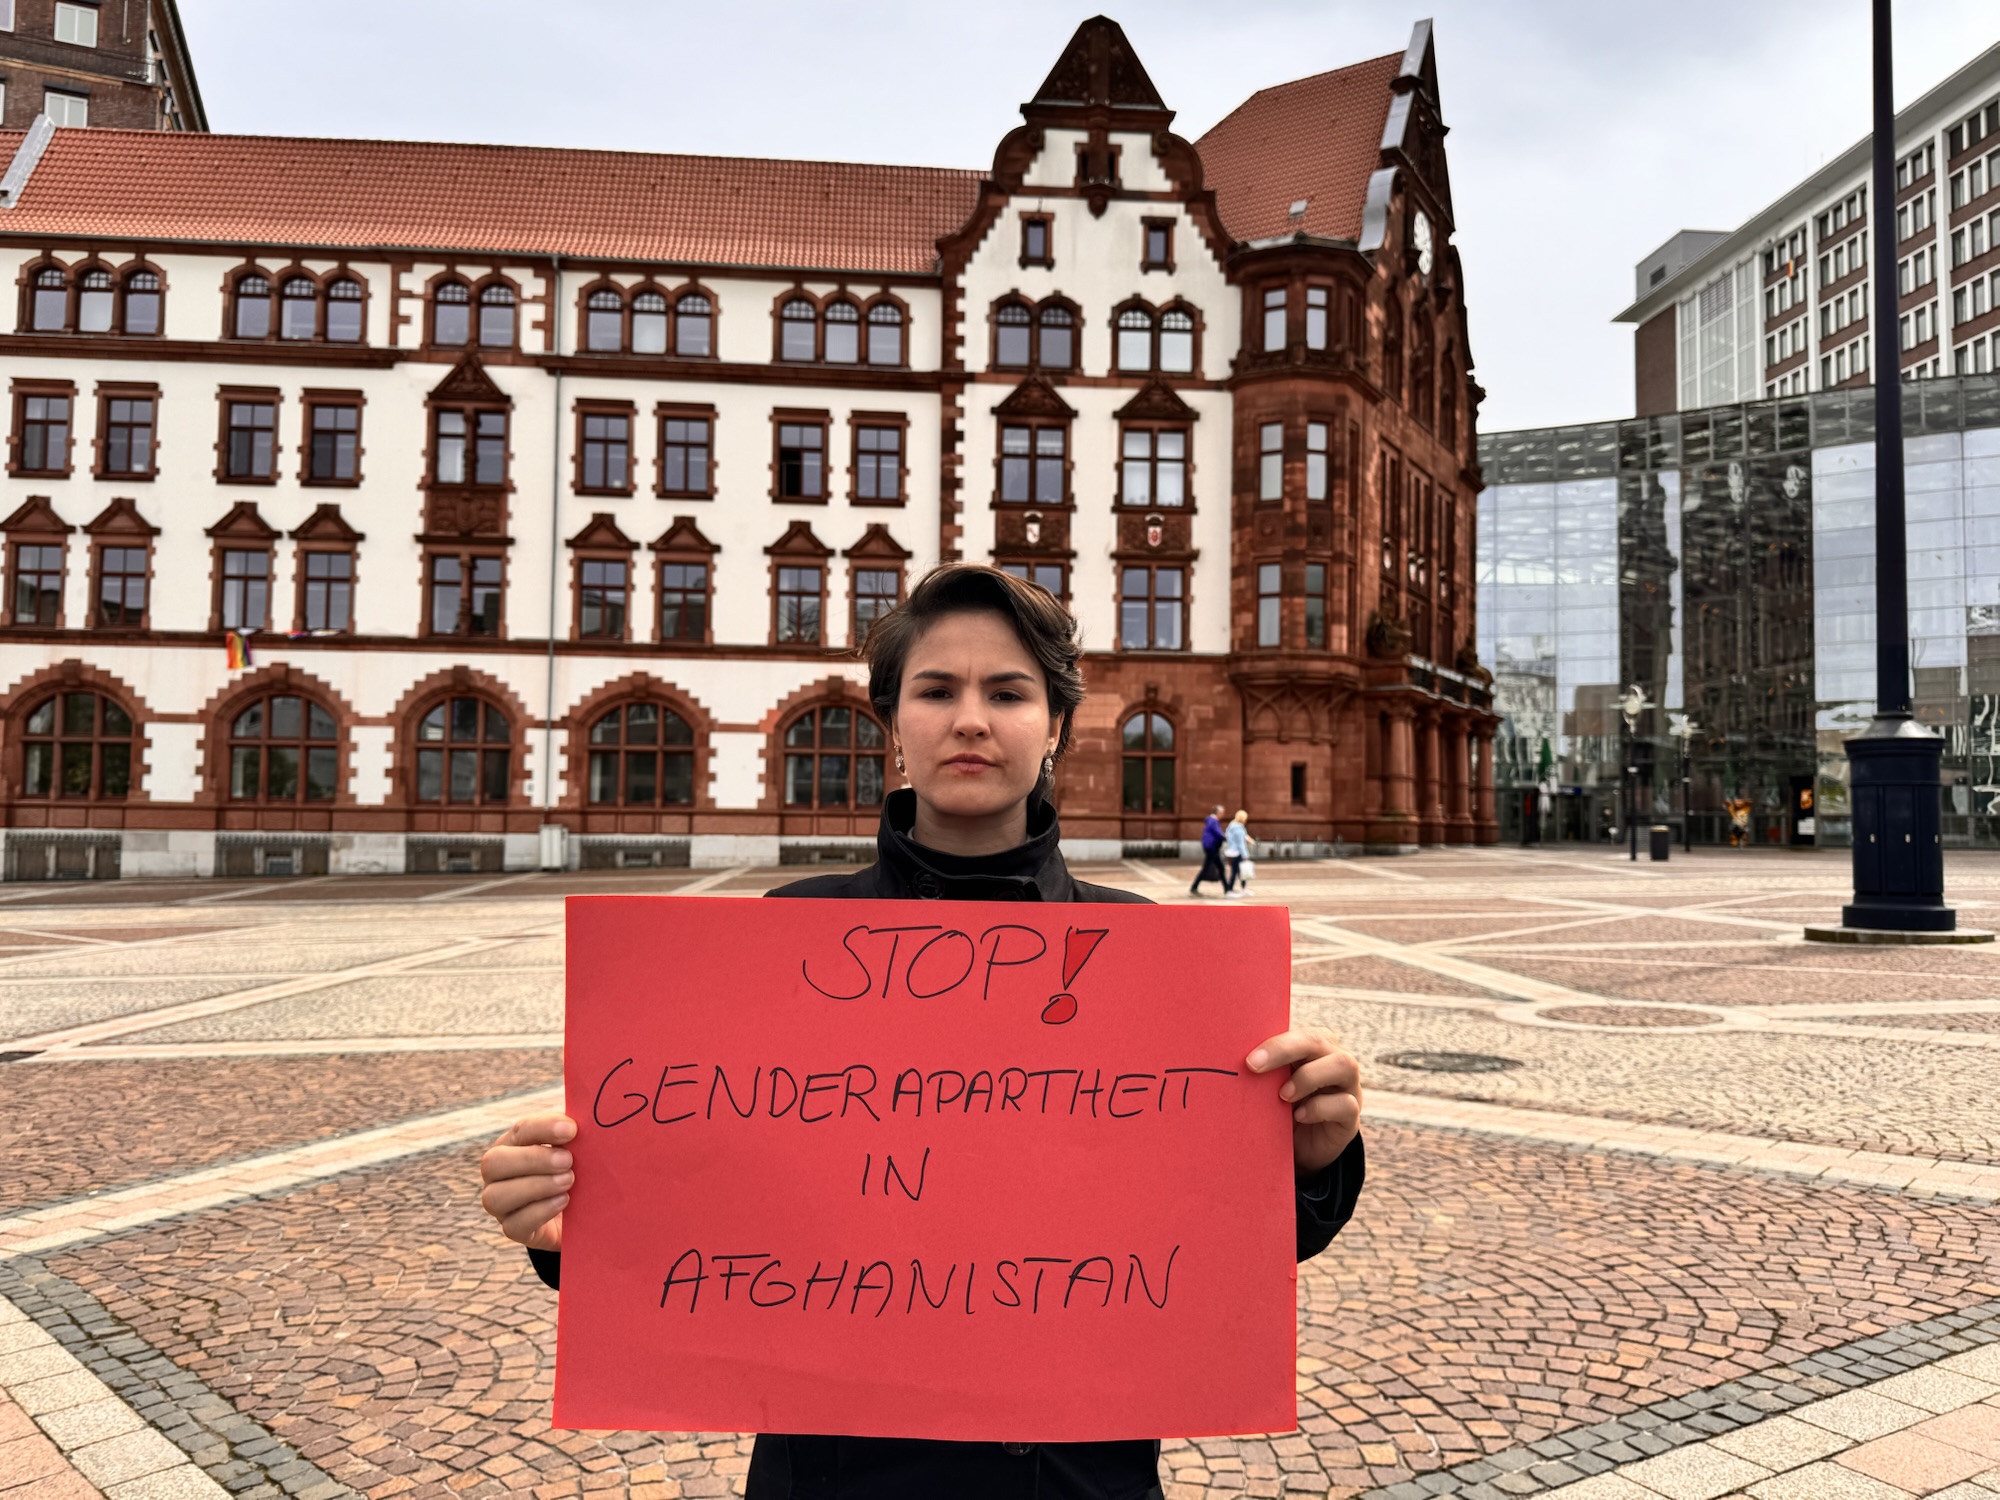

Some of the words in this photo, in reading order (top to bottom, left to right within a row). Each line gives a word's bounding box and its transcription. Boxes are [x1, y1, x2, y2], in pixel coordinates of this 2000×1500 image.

[802, 923, 1111, 1026] STOP!
[861, 1146, 931, 1202] IN
[658, 1243, 1182, 1319] AFGHANISTAN
